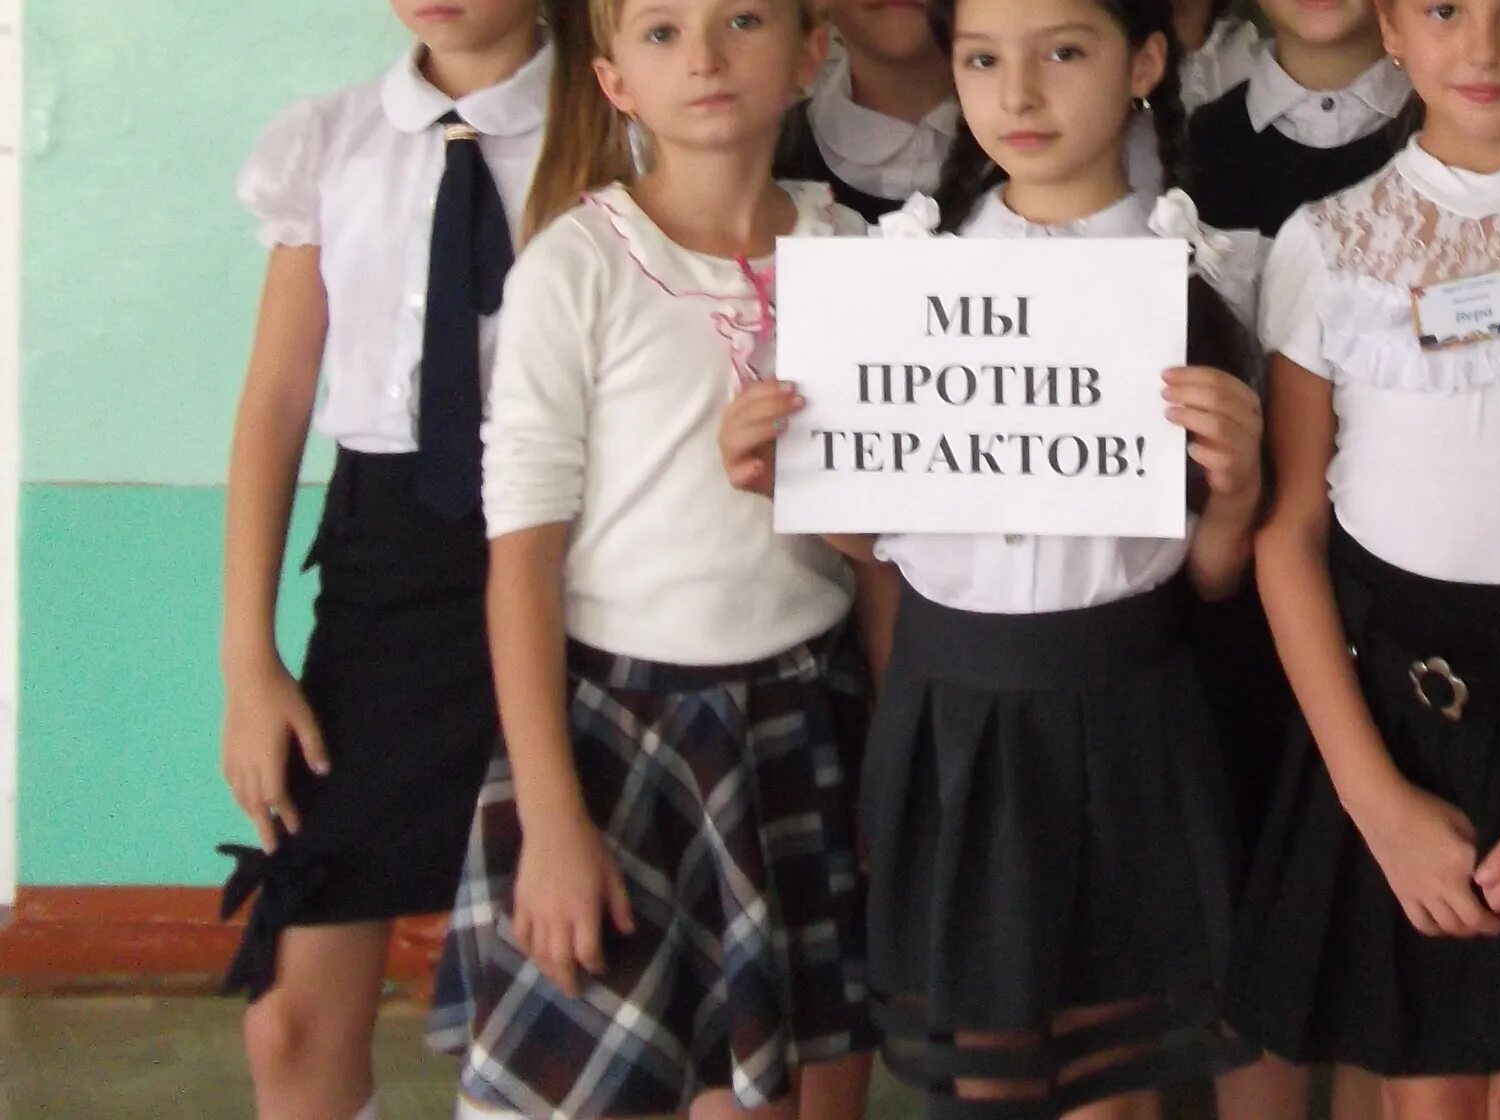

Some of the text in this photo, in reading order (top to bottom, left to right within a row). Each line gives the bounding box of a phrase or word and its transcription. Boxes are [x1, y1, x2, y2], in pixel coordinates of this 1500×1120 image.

[926, 295, 1029, 337] МЫ
[857, 363, 1102, 407] ПРОТИВ
[810, 429, 1146, 477] ТЕРАКТОВ!
